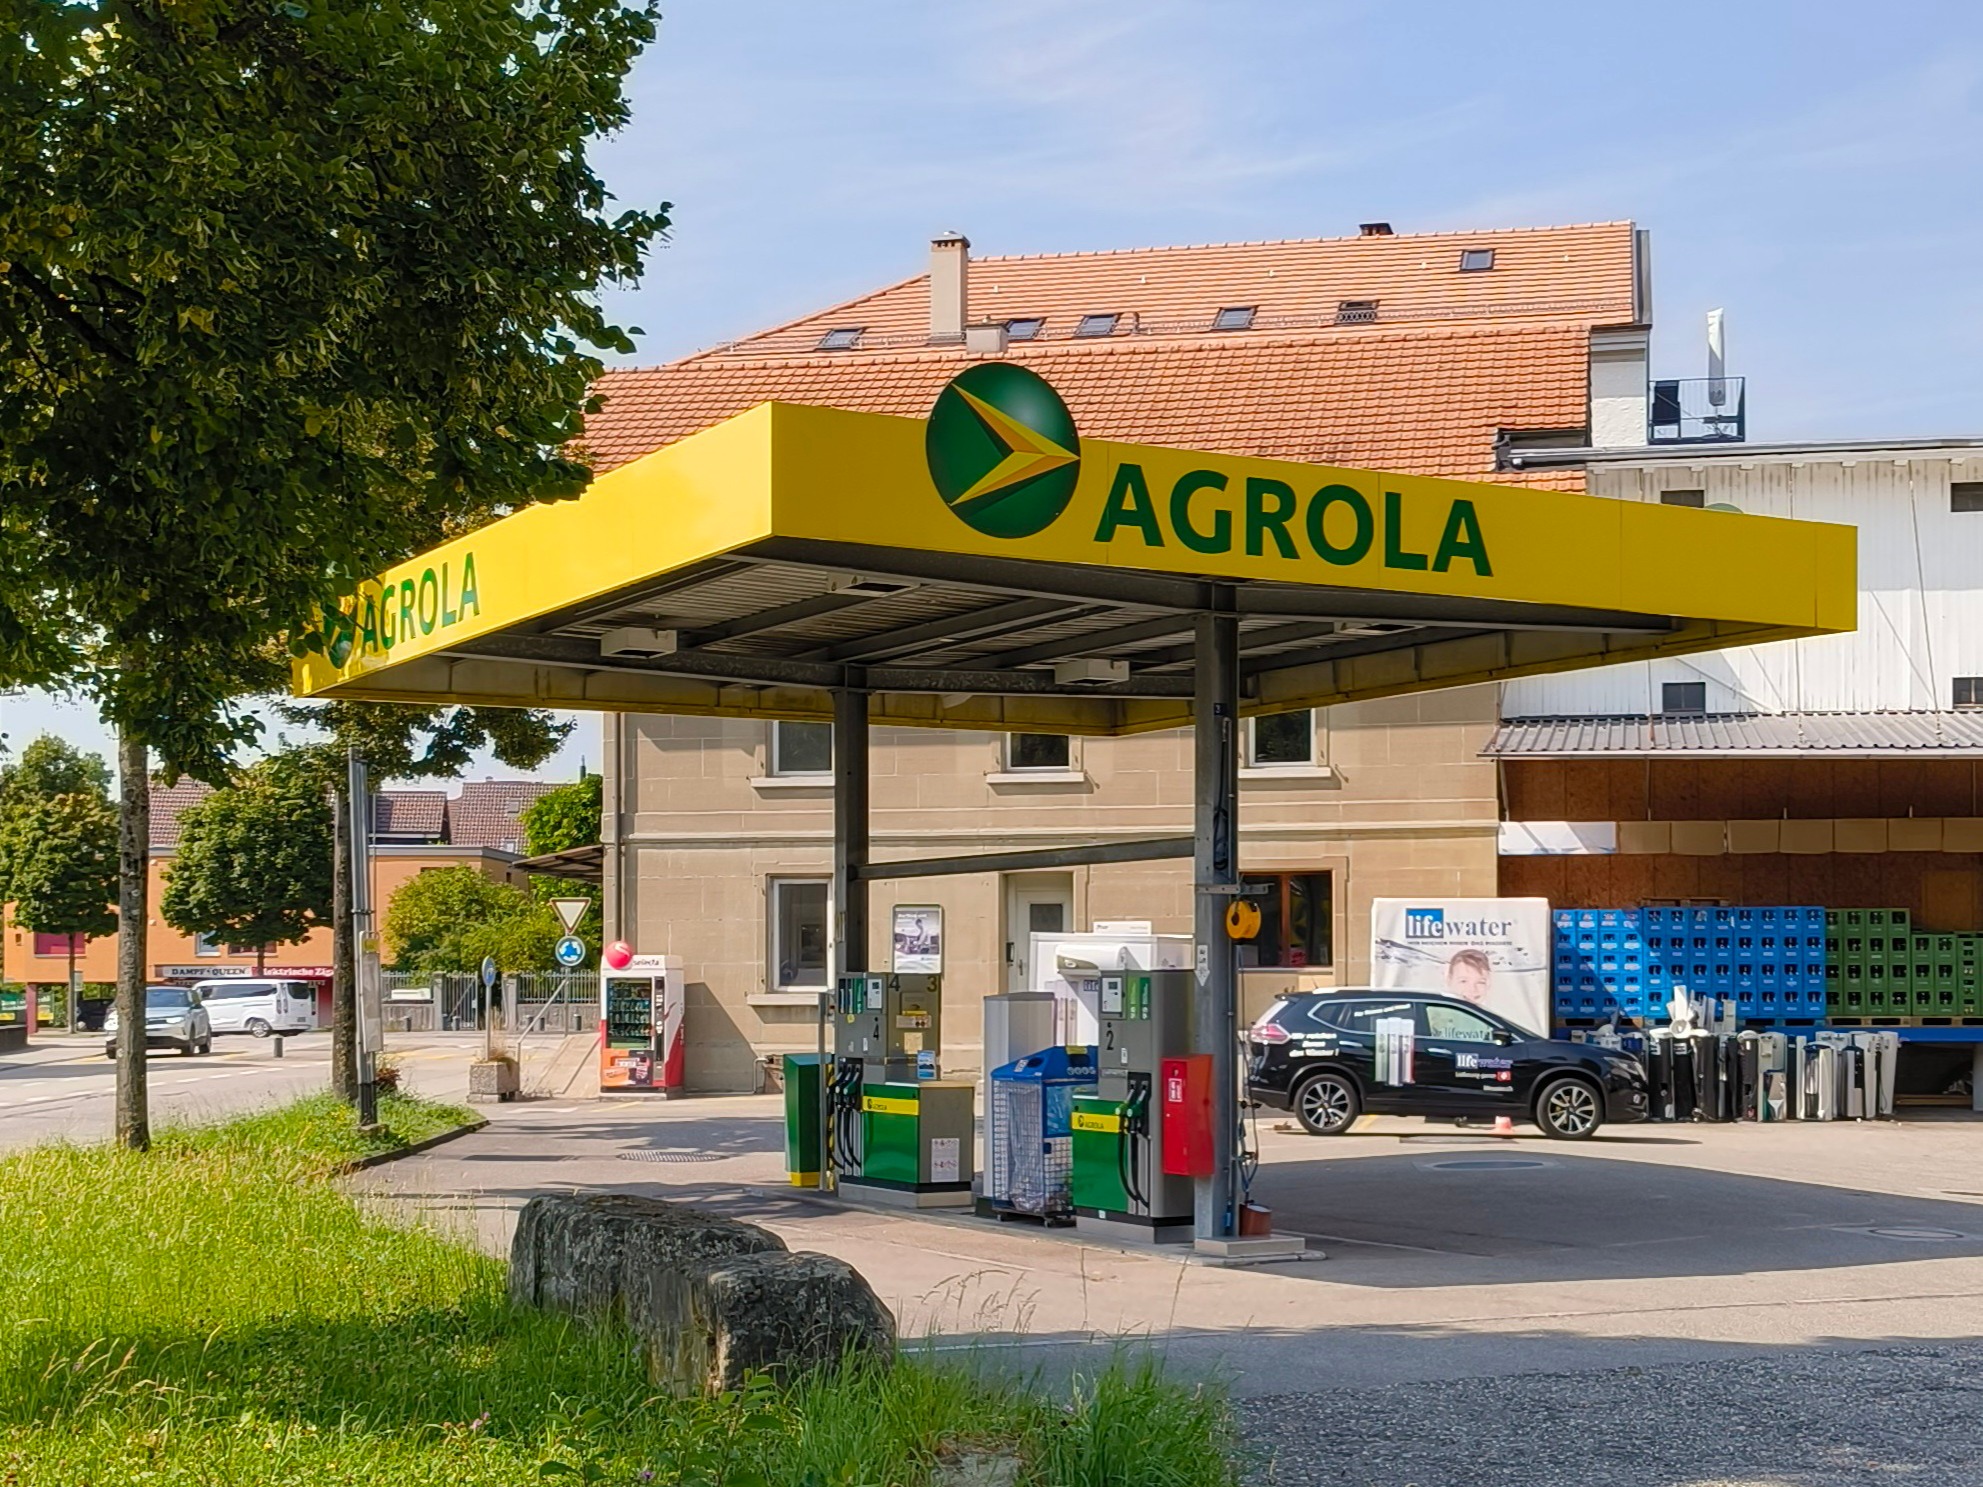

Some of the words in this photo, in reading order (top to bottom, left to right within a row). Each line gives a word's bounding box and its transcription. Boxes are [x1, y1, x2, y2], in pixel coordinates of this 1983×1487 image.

[1093, 463, 1493, 577] AGROLA
[362, 552, 481, 658] AGROLA
[889, 974, 901, 992] 4
[926, 975, 938, 993] 3
[873, 1024, 879, 1041] 4
[1106, 1031, 1115, 1051] 2
